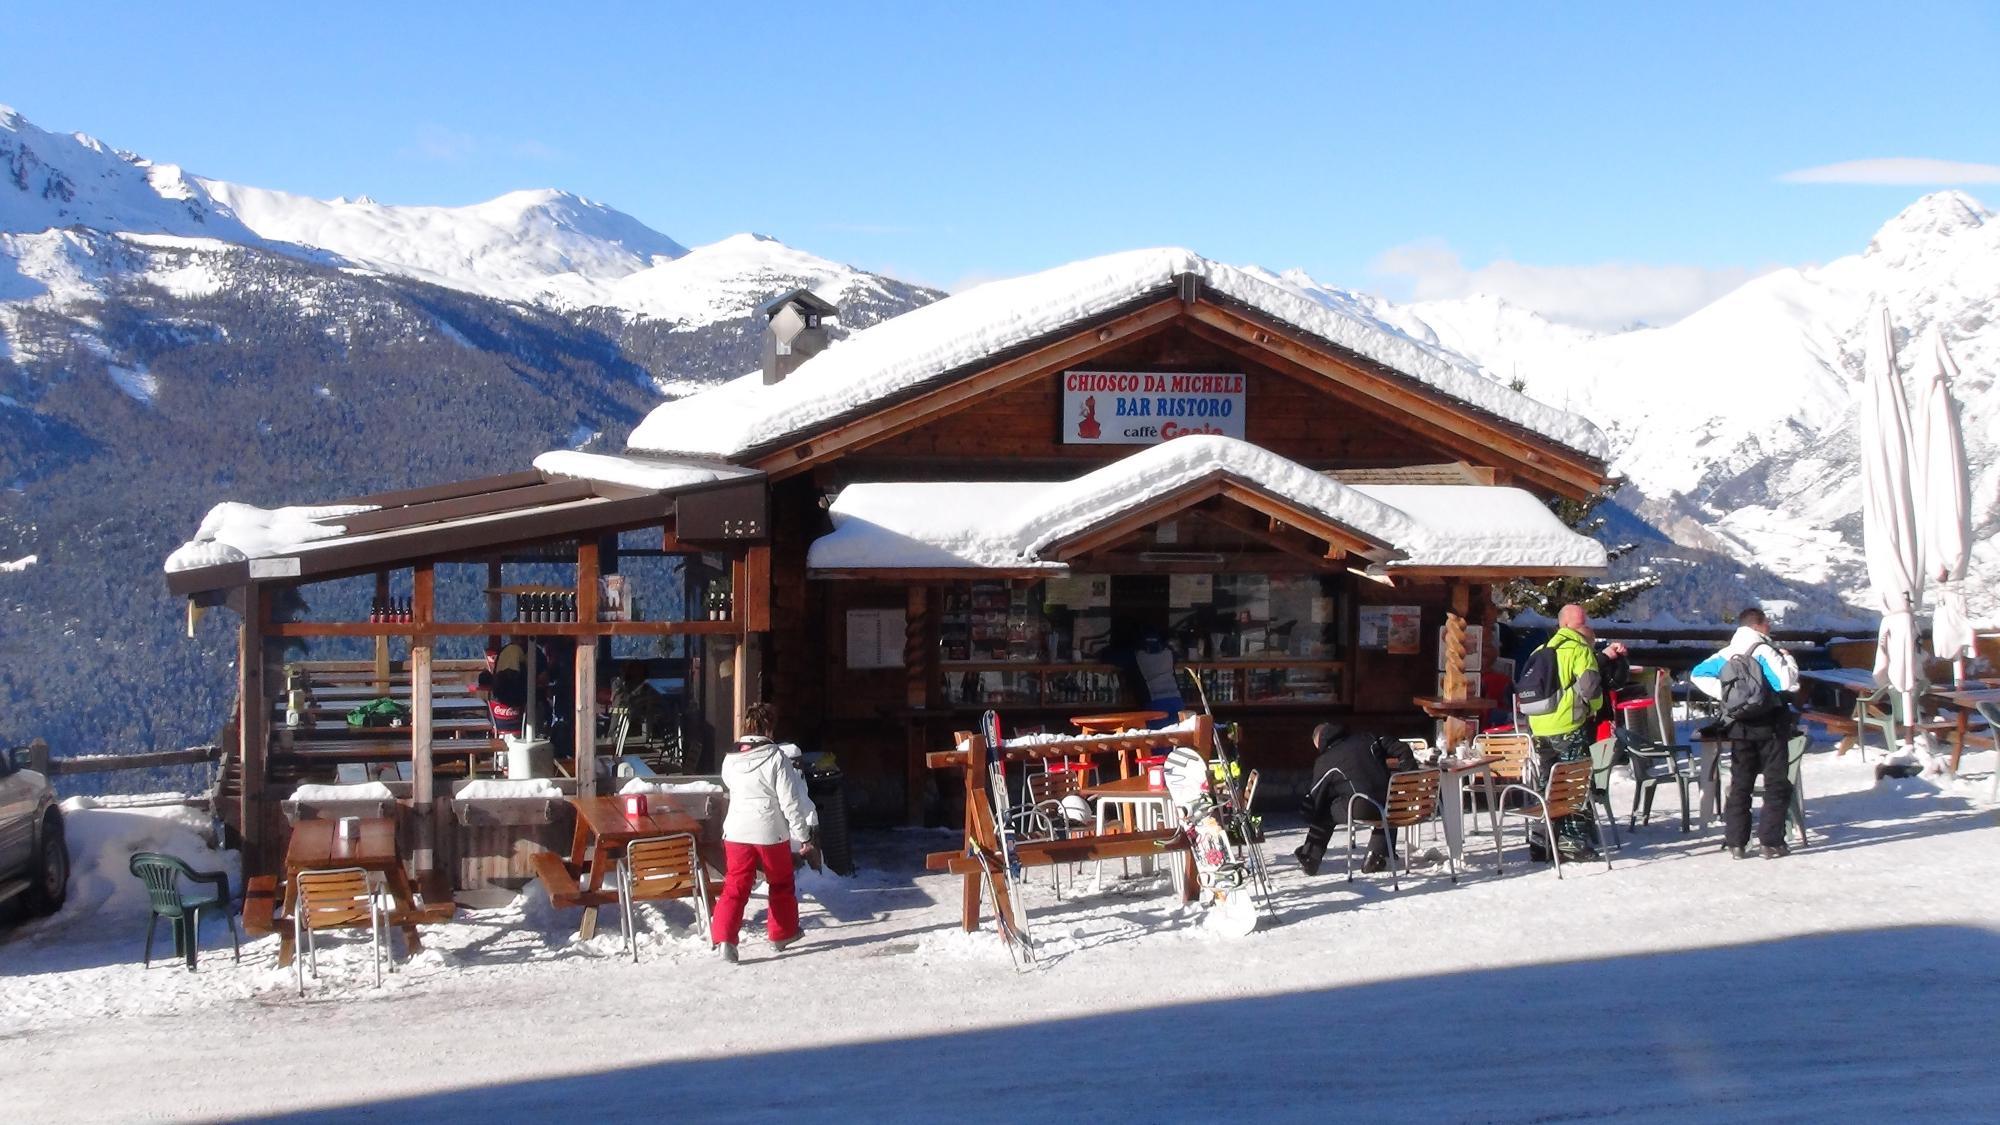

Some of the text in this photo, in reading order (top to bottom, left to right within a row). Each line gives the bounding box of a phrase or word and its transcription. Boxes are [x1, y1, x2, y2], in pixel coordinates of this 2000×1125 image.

[1067, 374, 1243, 393] CHIOSCO DA MICHELE
[1115, 397, 1233, 417] BAR RISTORO
[1123, 426, 1158, 438] caffè
